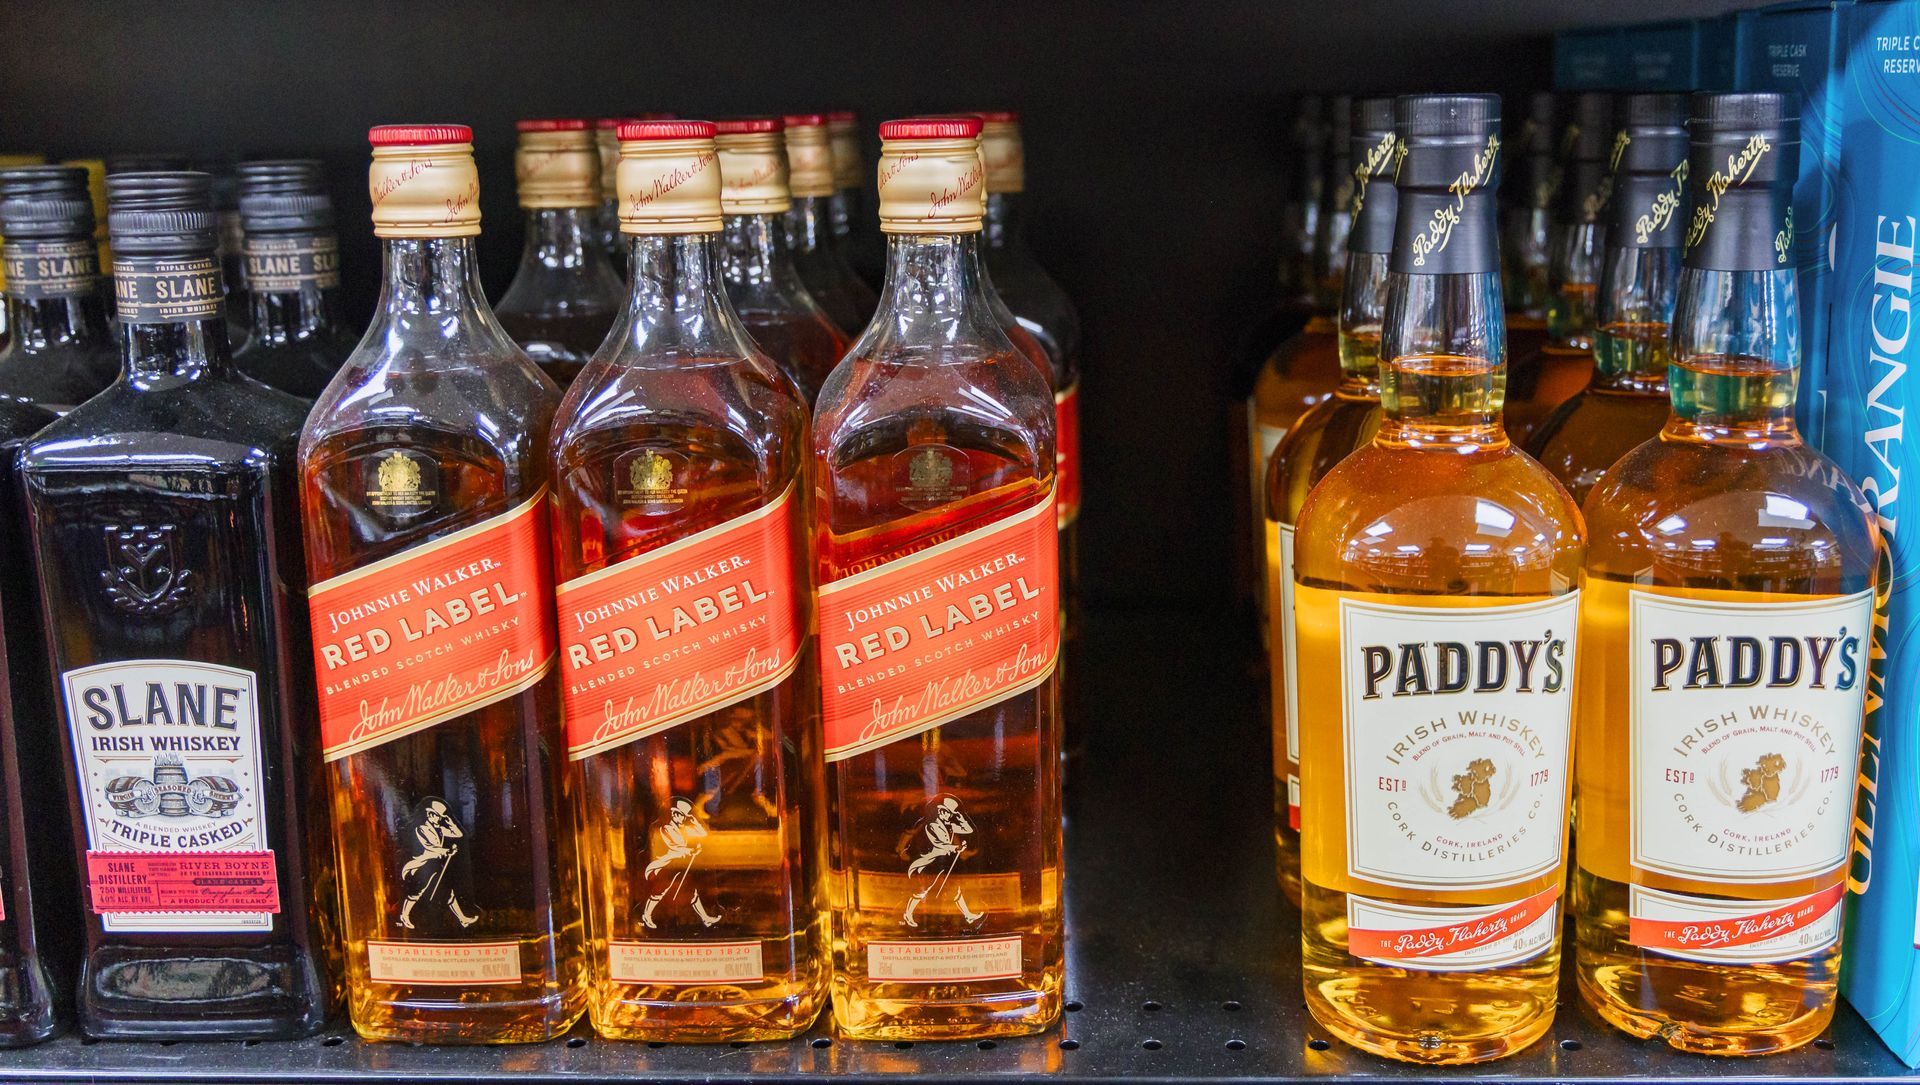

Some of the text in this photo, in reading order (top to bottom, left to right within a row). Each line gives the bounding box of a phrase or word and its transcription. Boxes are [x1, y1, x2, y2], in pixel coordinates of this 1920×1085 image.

[1877, 36, 1910, 51] TRIPLE
[653, 168, 691, 198] Walker
[1706, 134, 1770, 211] Flaherty
[1413, 205, 1460, 266] Paddy
[1636, 189, 1680, 243] Paddy
[249, 256, 301, 274] SLANE
[156, 277, 216, 299] SLANE
[328, 558, 494, 634] JOHNNIE WALKER
[575, 555, 744, 633] JOHNNIE WALKER
[845, 552, 1019, 632] JOHNNIE WALKER
[321, 581, 519, 670] RED LABEL
[568, 580, 767, 670] RED LABEL
[834, 576, 1040, 670] RED LABEL
[326, 617, 520, 695] BLENDED SCOTCH WHISKY
[571, 615, 768, 695] BLENDED SCOTCH WHISKY
[837, 611, 1040, 695] BLENDED SCOTCH WHISKY
[1361, 629, 1566, 700] PADDY'S
[1651, 626, 1861, 692] PADDY'S
[83, 681, 240, 731] SLANE
[349, 697, 401, 743] John
[400, 673, 477, 719] Walker
[491, 649, 534, 686] Sons
[593, 696, 648, 745] John
[647, 671, 725, 716] Walker
[737, 648, 780, 685] Sons
[858, 695, 918, 744] John
[917, 668, 995, 714] Walker
[1008, 643, 1048, 681] Sons
[91, 736, 241, 751] IRISH WHISKEY
[1386, 710, 1545, 765] IRISH WHISKEY
[1412, 745, 1431, 762] BLEND
[1442, 733, 1467, 743] GRAIN,
[1673, 705, 1836, 758] IRISH WHISKEY
[1701, 738, 1721, 754] BLEND
[1722, 733, 1731, 741] OF
[1733, 726, 1758, 737] GRAIN,
[1759, 725, 1778, 733] MALT
[1780, 727, 1793, 735] AND
[154, 784, 192, 794] SEASONED
[1531, 769, 1549, 786] 1779
[1821, 766, 1839, 783] 1779
[111, 820, 243, 848] TRIPLE CASKED
[143, 824, 180, 833] BLENDED
[182, 822, 216, 833] WHISKEY
[1387, 801, 1416, 841] CORK
[1421, 826, 1526, 862] DISTILLERIES
[1436, 833, 1503, 848] CORK, IRELAND
[1674, 793, 1703, 833] CORK
[1707, 822, 1815, 856] DISTILLERIES
[1723, 828, 1791, 842] CORK, IRELAND
[98, 874, 147, 885] DISTILLERY
[108, 862, 135, 873] SLANE
[180, 862, 220, 870] RIVER
[225, 861, 269, 870] BOYNE
[380, 947, 508, 956] ESTABLISHED 1820
[621, 947, 751, 956] ESTABLISHED 1820
[880, 943, 1011, 954] ESTABLISHED 1820
[1380, 939, 1392, 948] THE
[1394, 932, 1444, 955] Paddy
[1446, 914, 1508, 945] Flaherty
[1664, 930, 1675, 939] THE
[1677, 924, 1730, 947] Paddy
[1732, 911, 1795, 938] Flaherty
